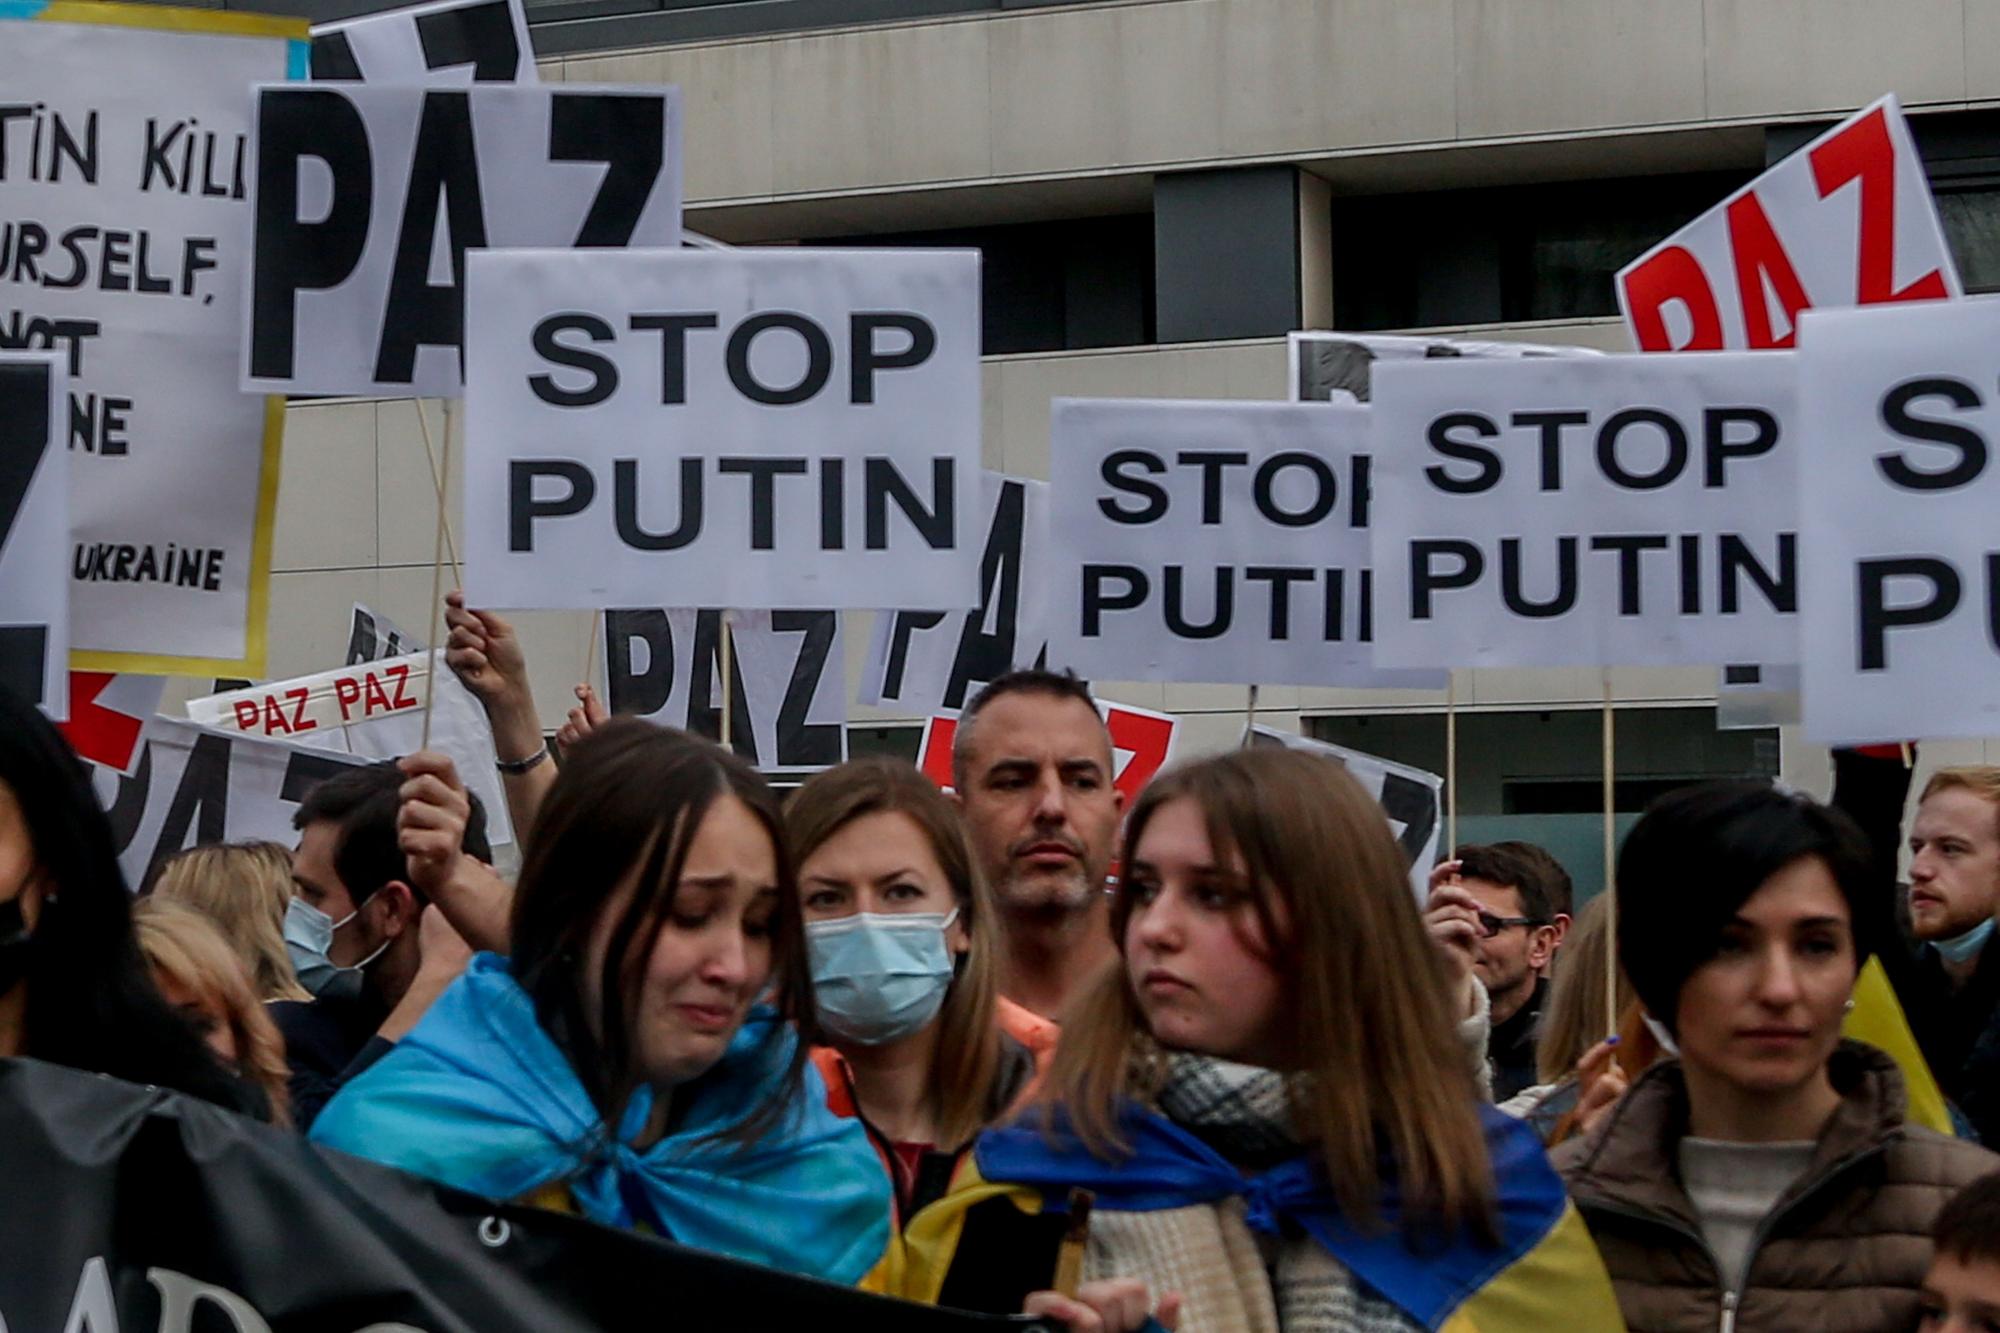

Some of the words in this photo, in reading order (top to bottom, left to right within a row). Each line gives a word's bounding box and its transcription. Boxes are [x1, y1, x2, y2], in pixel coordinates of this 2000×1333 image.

[528, 312, 936, 406] STOP
[1425, 408, 1779, 493] STOP
[1877, 379, 2000, 490] S
[509, 457, 956, 552] PUTIN
[1410, 533, 1797, 619] PUTIN
[1857, 554, 2000, 670] P
[233, 687, 318, 736] PAZ
[333, 664, 417, 721] PAZ
